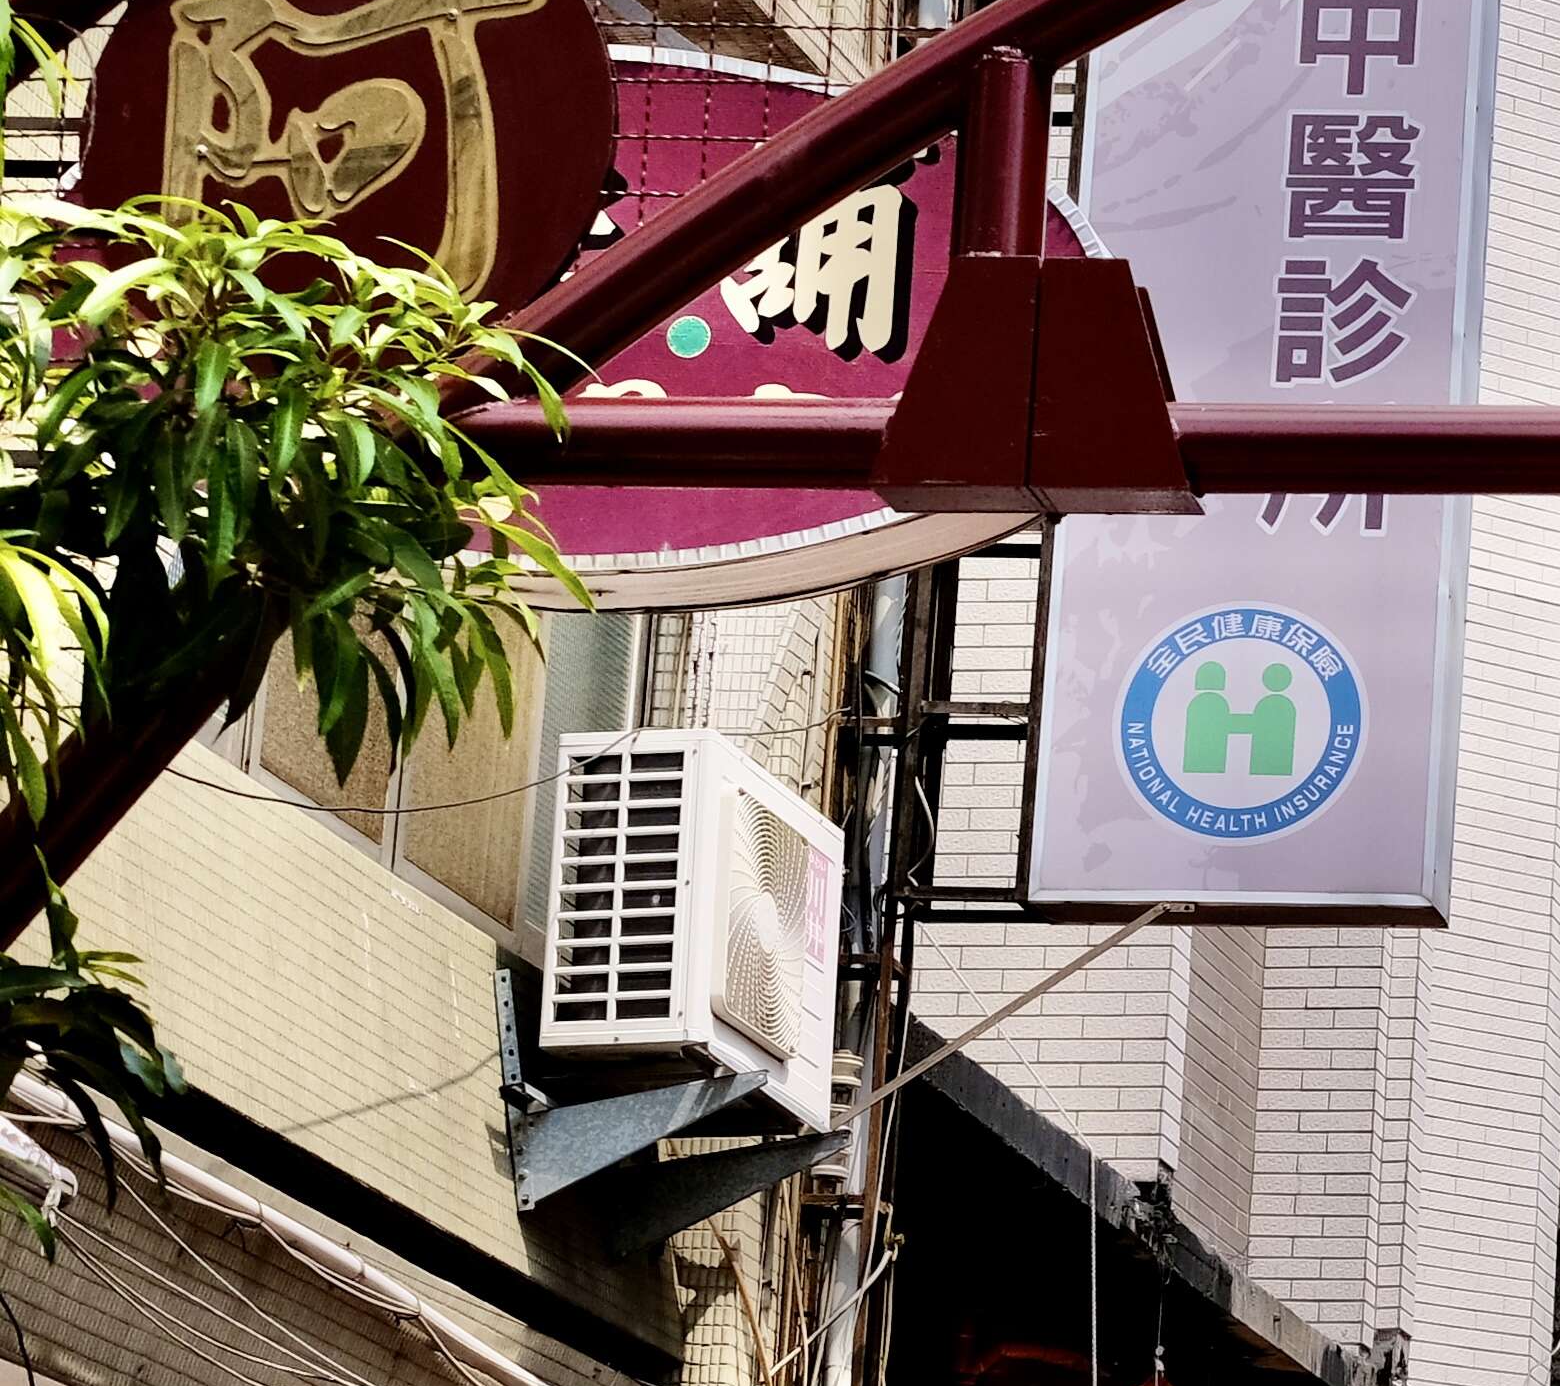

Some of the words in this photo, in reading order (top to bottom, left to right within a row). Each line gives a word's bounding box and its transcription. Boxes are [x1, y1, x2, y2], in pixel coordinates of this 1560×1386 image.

[1146, 612, 1344, 681] 全民健康保險
[1127, 722, 1177, 813] NATIONAL
[1185, 804, 1268, 832] HEALTH
[1275, 724, 1354, 823] INSURANCE
